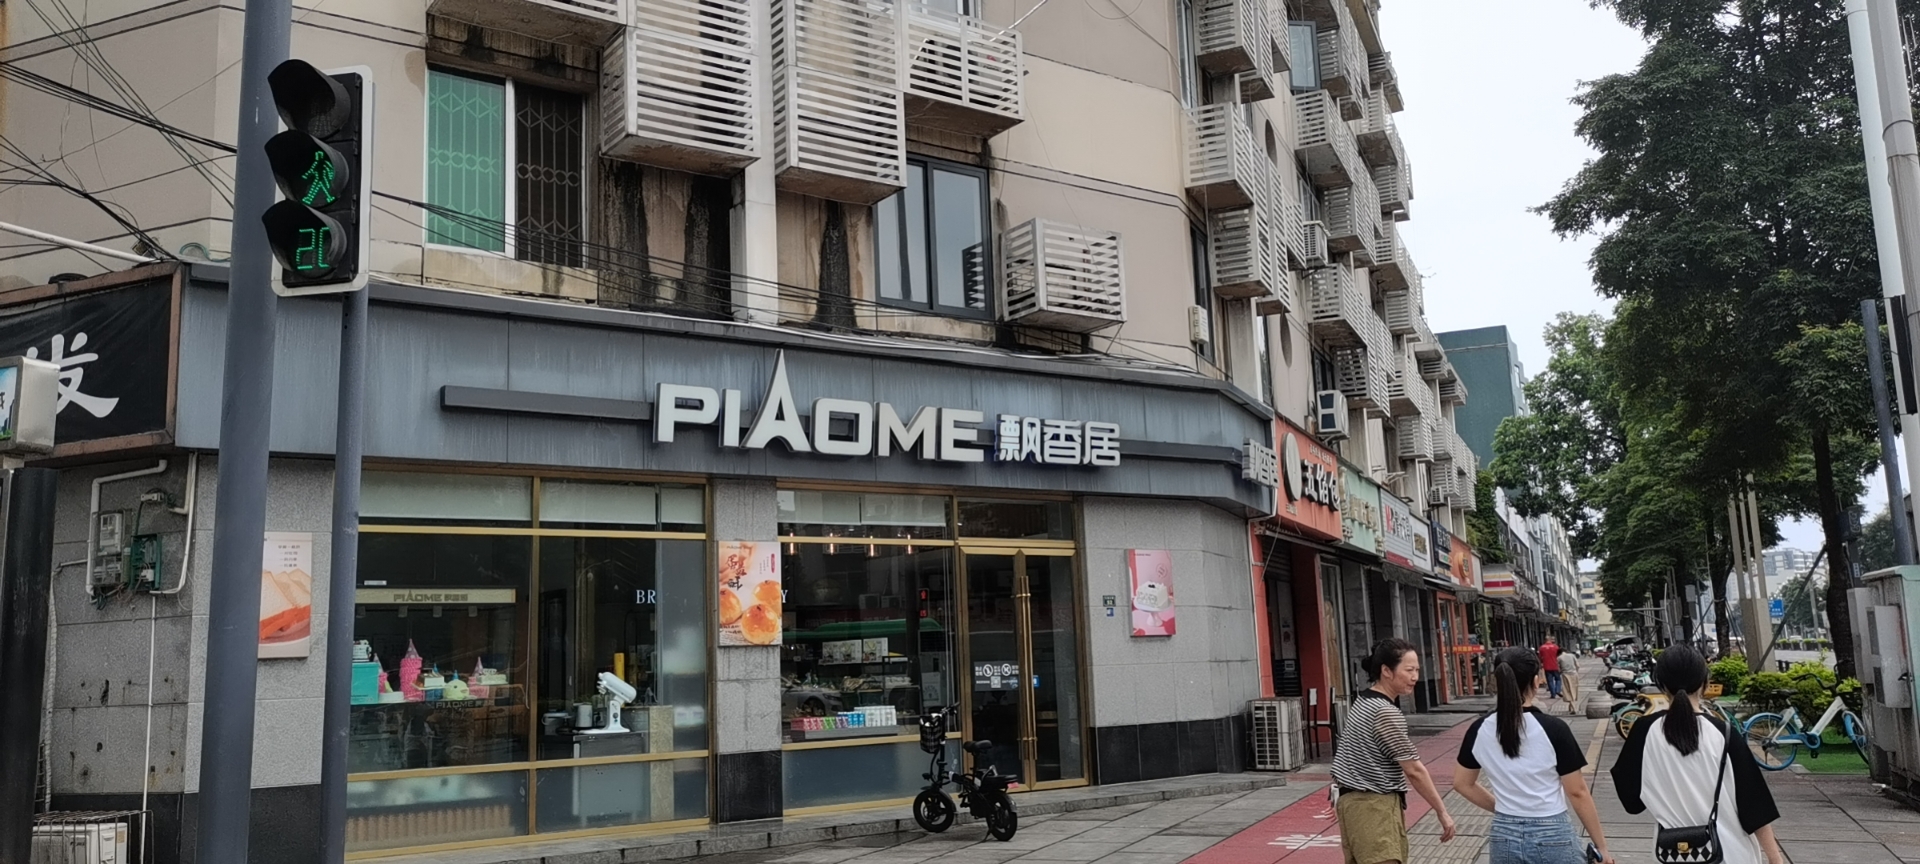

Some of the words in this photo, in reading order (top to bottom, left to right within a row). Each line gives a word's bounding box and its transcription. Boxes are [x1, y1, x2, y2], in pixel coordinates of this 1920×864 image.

[653, 349, 985, 463] PIAOME
[996, 413, 1121, 467] 飘香居
